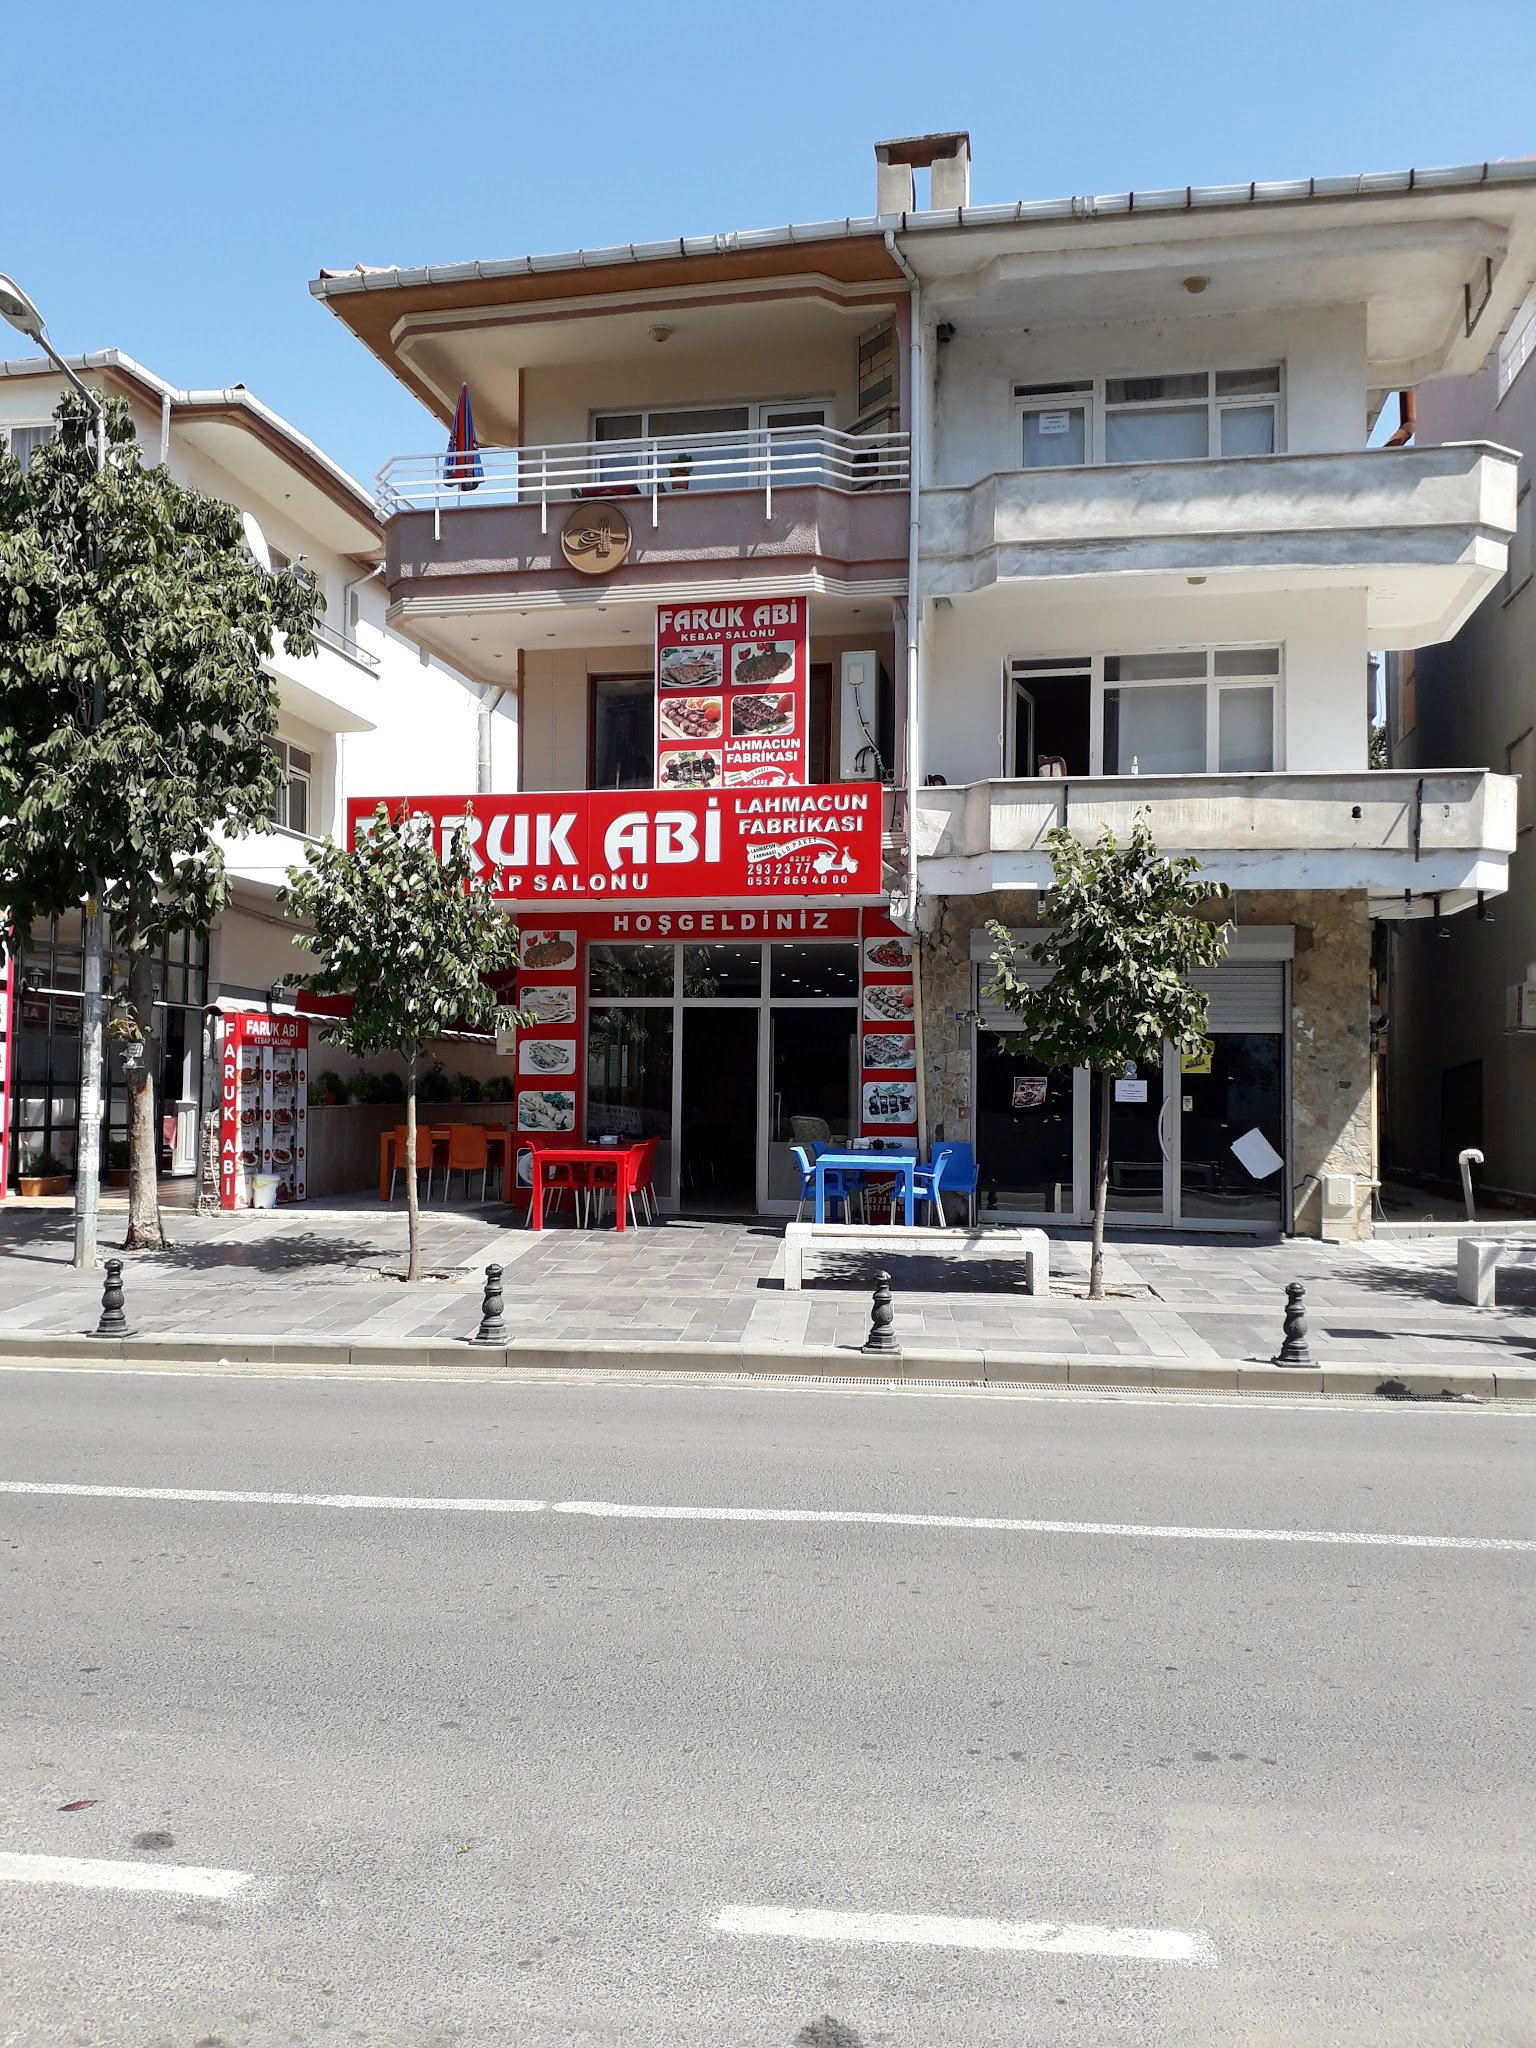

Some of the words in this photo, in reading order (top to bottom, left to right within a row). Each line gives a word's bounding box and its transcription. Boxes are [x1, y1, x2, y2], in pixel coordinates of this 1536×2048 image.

[659, 606, 745, 634] FARUK
[752, 598, 798, 628] ABİ
[680, 631, 722, 642] KEBAP
[725, 628, 776, 639] SALONU
[724, 737, 801, 751] LAHMACUN
[726, 749, 798, 764] FABRİKASI
[734, 793, 869, 814] LAHMACUN
[603, 796, 722, 872] ABİ
[738, 813, 864, 835] FABRİKASI
[777, 845, 791, 858] ALO
[792, 837, 817, 849] PAKET
[747, 863, 772, 875] 293
[775, 862, 792, 875] 23
[795, 861, 811, 874] 77
[533, 872, 649, 892] SALONU
[747, 876, 780, 886] 0537
[783, 875, 808, 885] 869
[811, 874, 828, 885] 40
[832, 874, 848, 884] 00
[613, 909, 829, 935] HOŞGELDİNİZ
[246, 1019, 280, 1036] FARUK
[281, 1021, 299, 1037] ABİ
[224, 1022, 236, 1121] FARUK
[222, 1138, 236, 1196] ABİ
